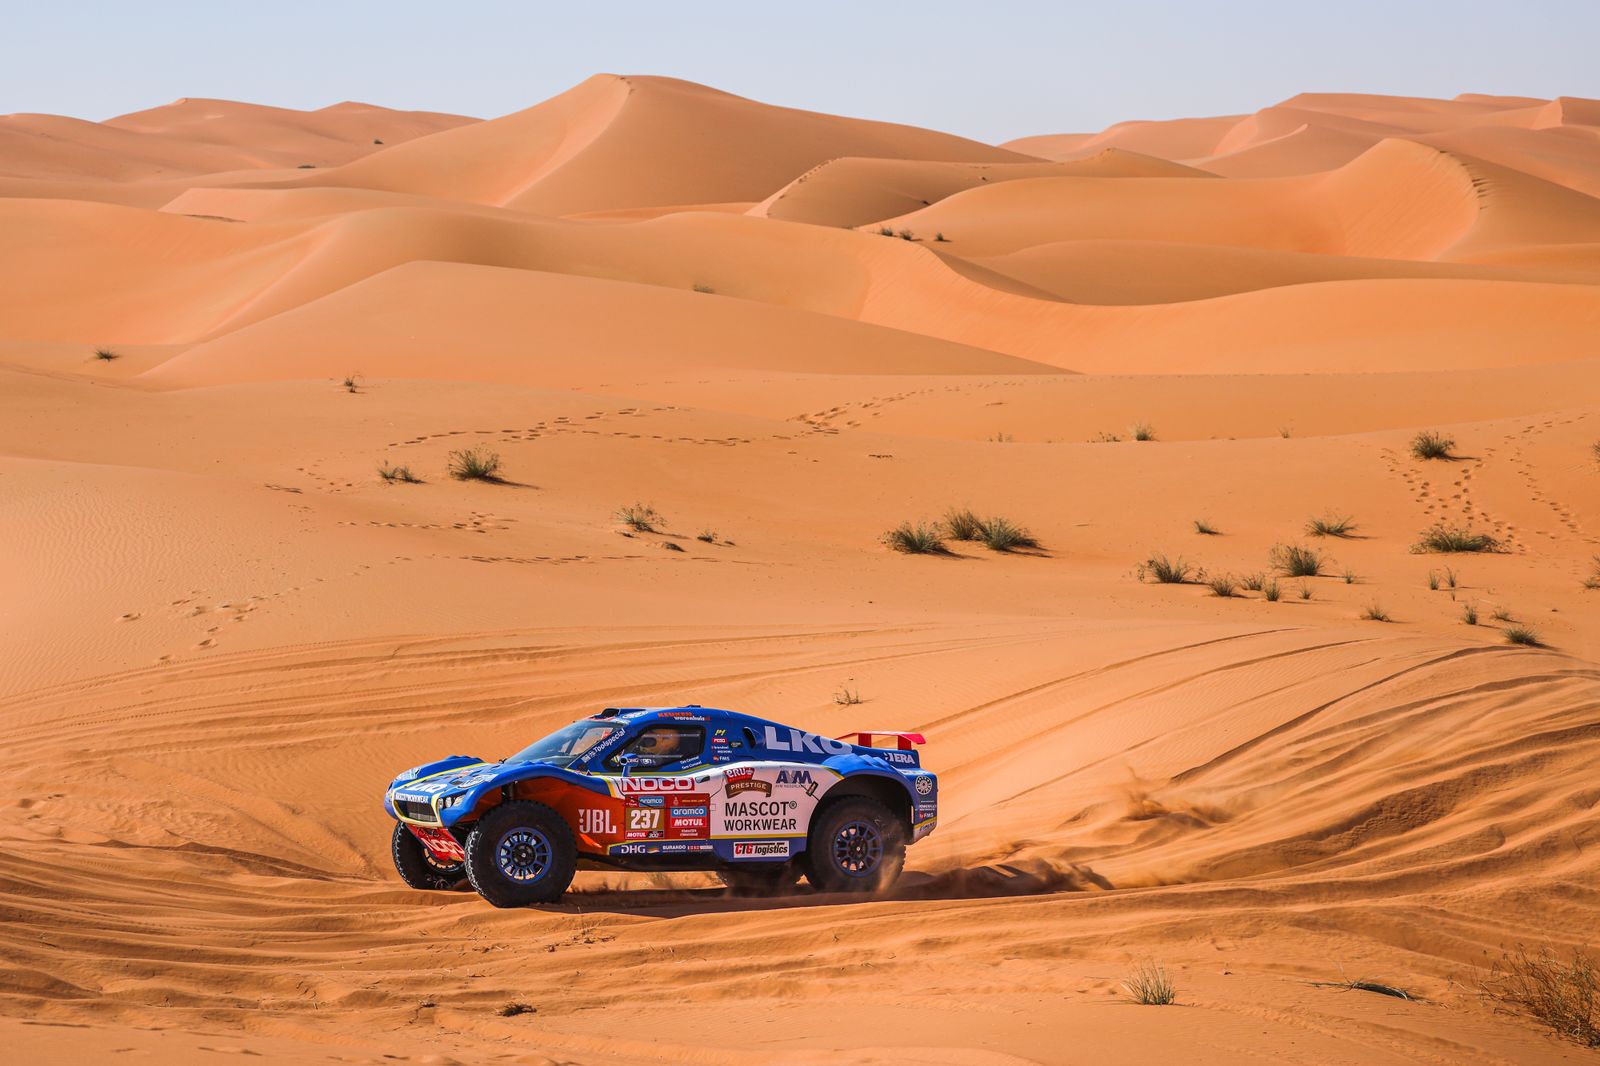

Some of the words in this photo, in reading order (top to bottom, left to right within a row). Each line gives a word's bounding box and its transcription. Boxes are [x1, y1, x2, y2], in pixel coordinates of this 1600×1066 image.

[622, 777, 693, 791] NOCO
[730, 782, 768, 790] PRESTIGE
[673, 807, 705, 817] aramco
[578, 809, 617, 834] JBL
[630, 809, 661, 830] 237
[674, 818, 704, 827] MOTUL
[724, 818, 797, 832] WORKWEAR
[620, 844, 646, 854] DHG
[735, 843, 753, 855] CTG
[754, 842, 788, 856] logistics
